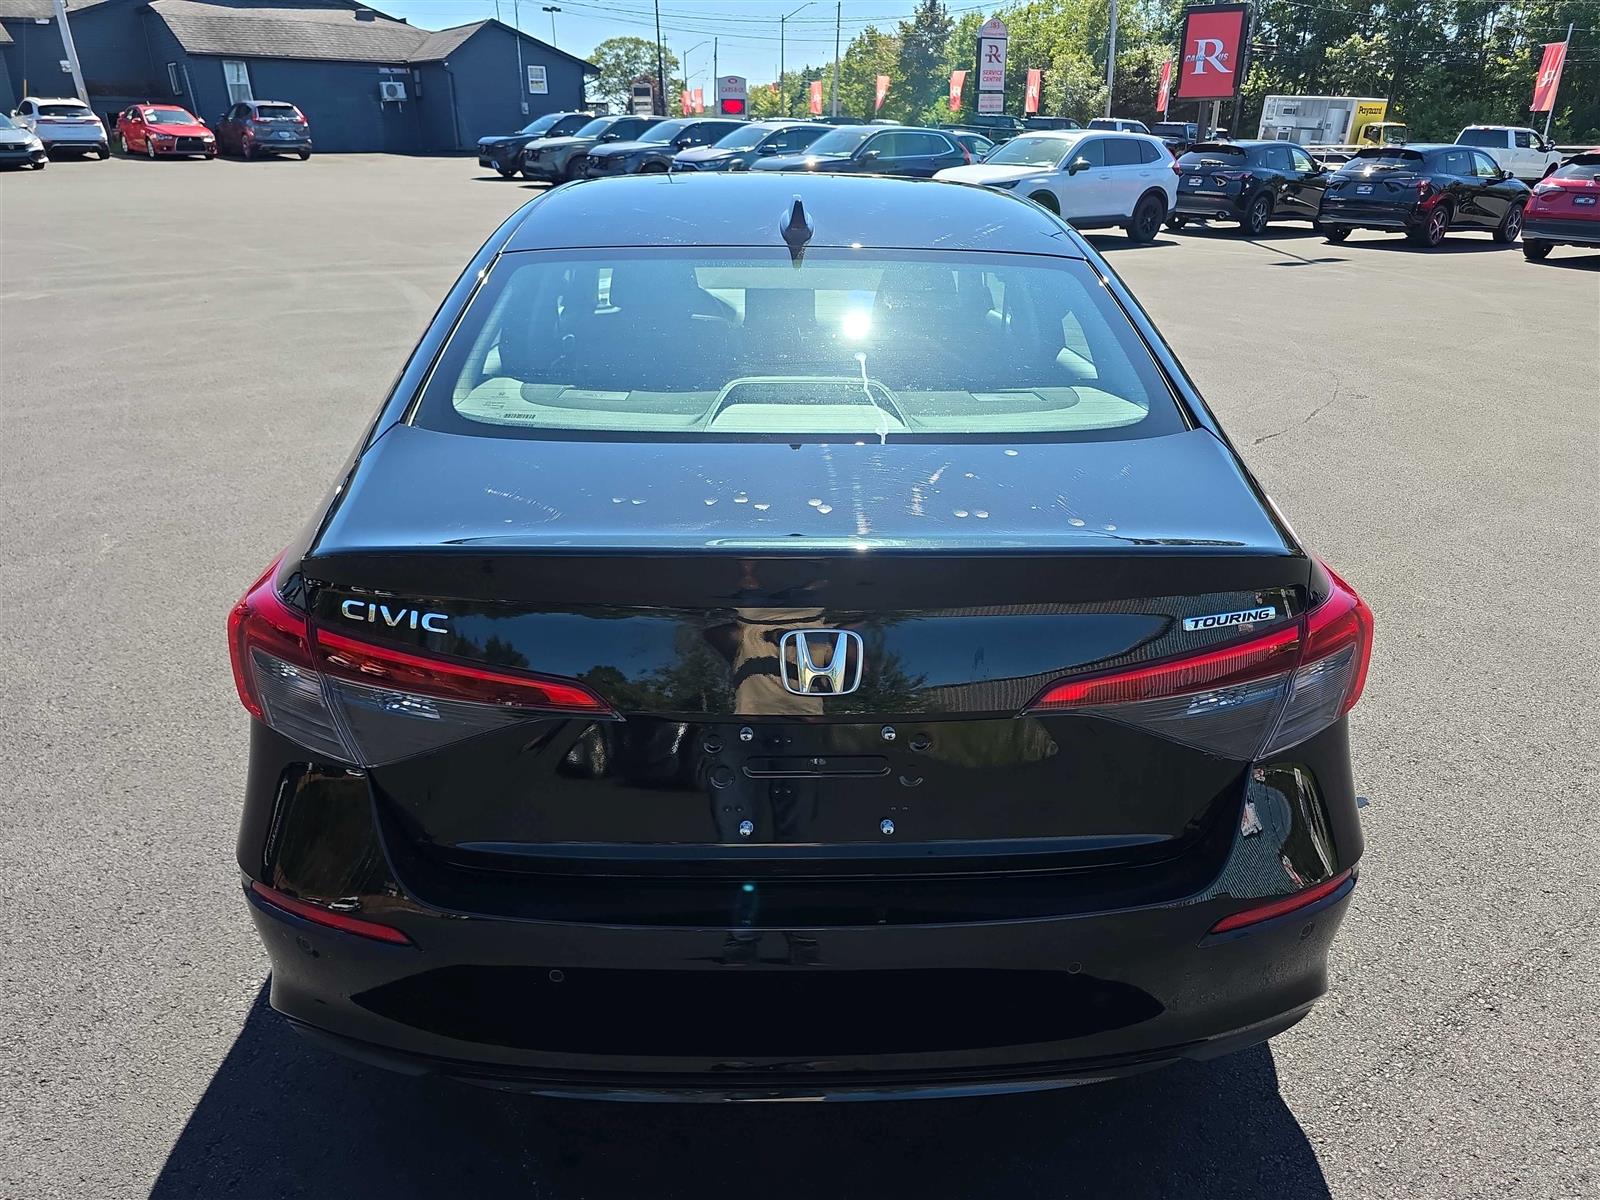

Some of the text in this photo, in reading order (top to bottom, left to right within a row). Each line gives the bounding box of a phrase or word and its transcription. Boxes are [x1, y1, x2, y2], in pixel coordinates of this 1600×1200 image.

[985, 44, 1003, 64] R
[1190, 39, 1233, 75] R
[342, 600, 449, 634] CIVIC
[1191, 609, 1270, 629] TOURING
